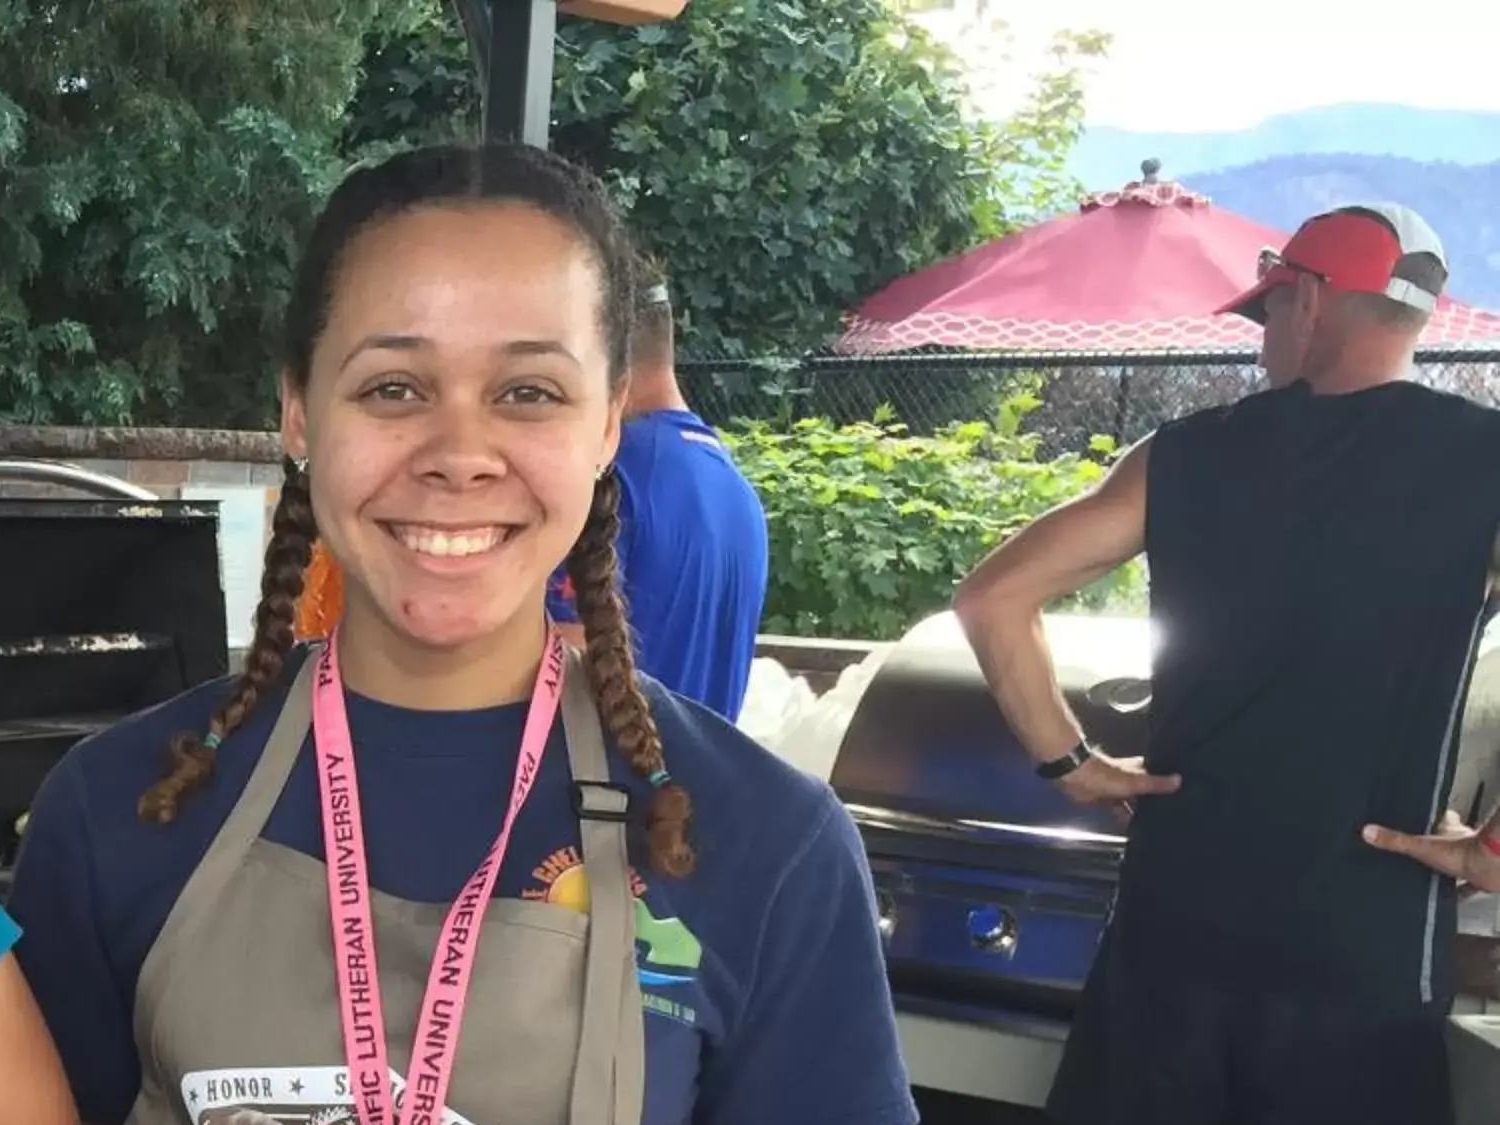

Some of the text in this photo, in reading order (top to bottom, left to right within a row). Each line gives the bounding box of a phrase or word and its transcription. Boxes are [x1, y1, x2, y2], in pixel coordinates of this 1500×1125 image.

[325, 751, 361, 907] UNIVERSITY
[343, 917, 378, 1062] LUTHERAN
[438, 850, 496, 988] UTHERAN
[206, 1077, 273, 1099] HONOR
